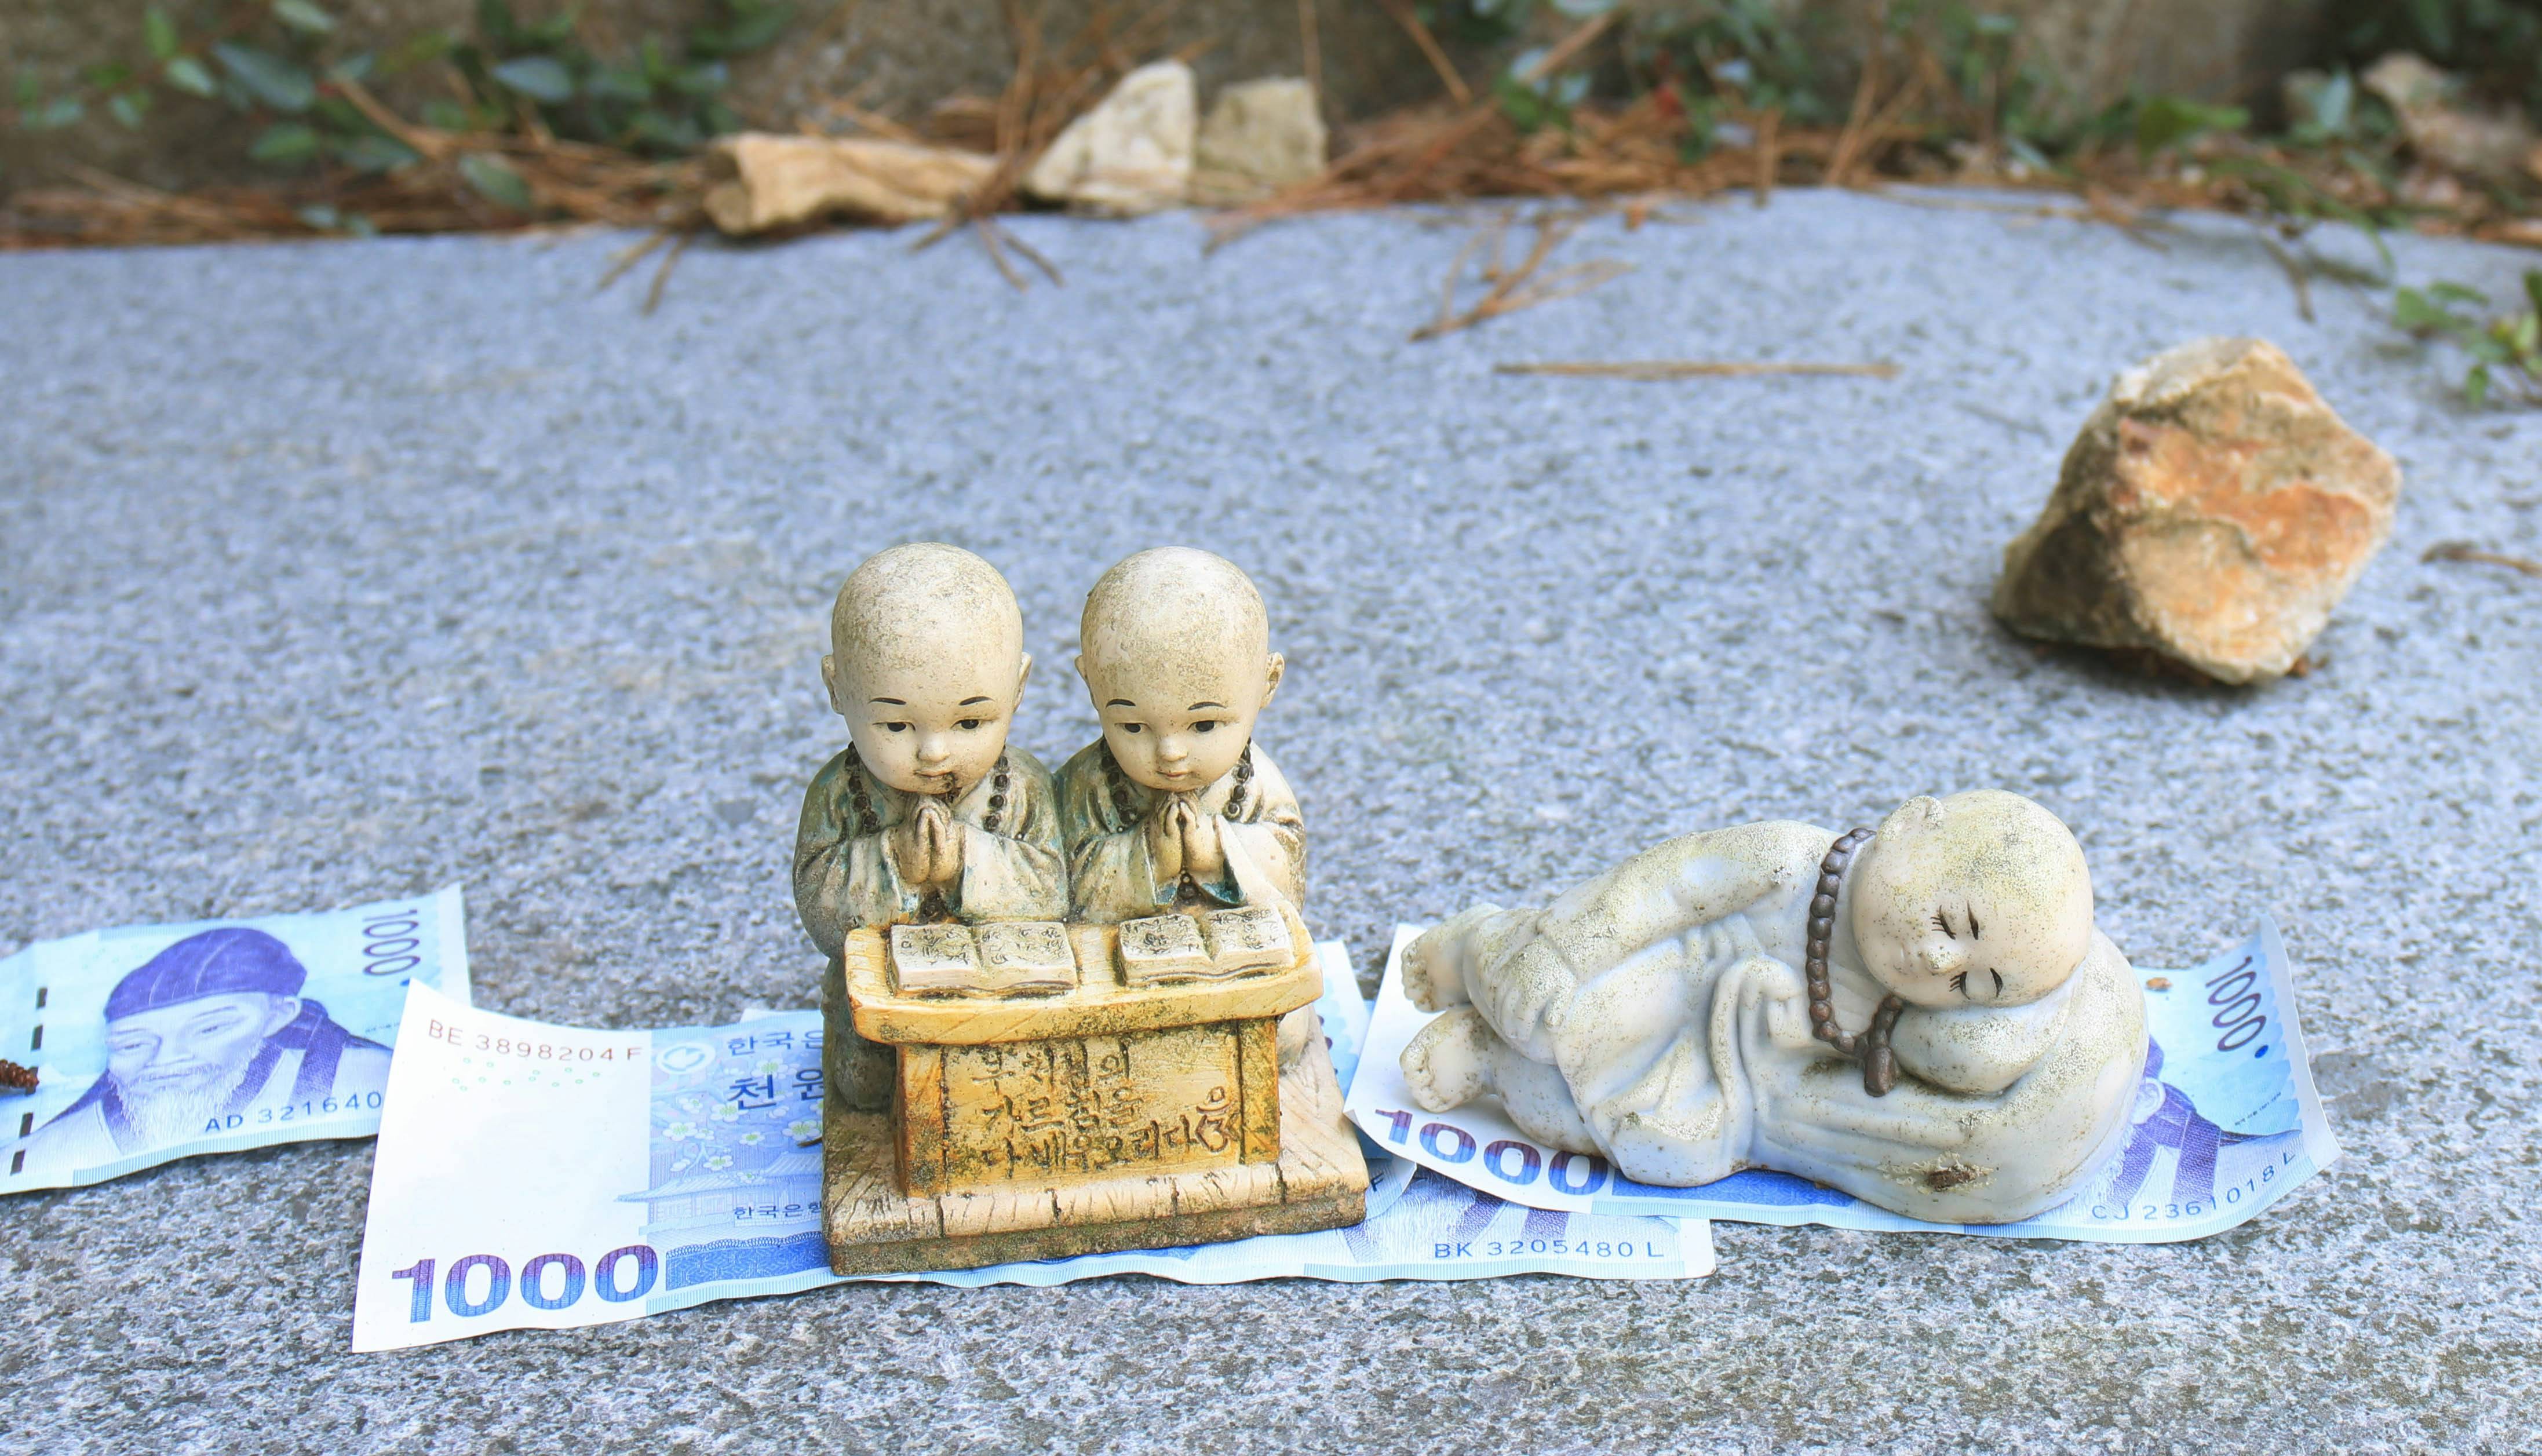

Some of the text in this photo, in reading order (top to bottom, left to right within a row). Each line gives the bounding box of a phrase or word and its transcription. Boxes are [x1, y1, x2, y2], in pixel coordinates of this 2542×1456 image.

[362, 908, 421, 976] 1000
[2205, 955, 2267, 1052] 1000
[428, 1019, 643, 1061] BE 3898204 F
[205, 1091, 382, 1133] AD 321640
[1374, 1108, 1609, 1196] 1000
[2091, 1152, 2295, 1221] CJ 2361018 L
[1434, 1240, 1665, 1259] BK 3205480 L
[391, 1244, 659, 1324] 1000
